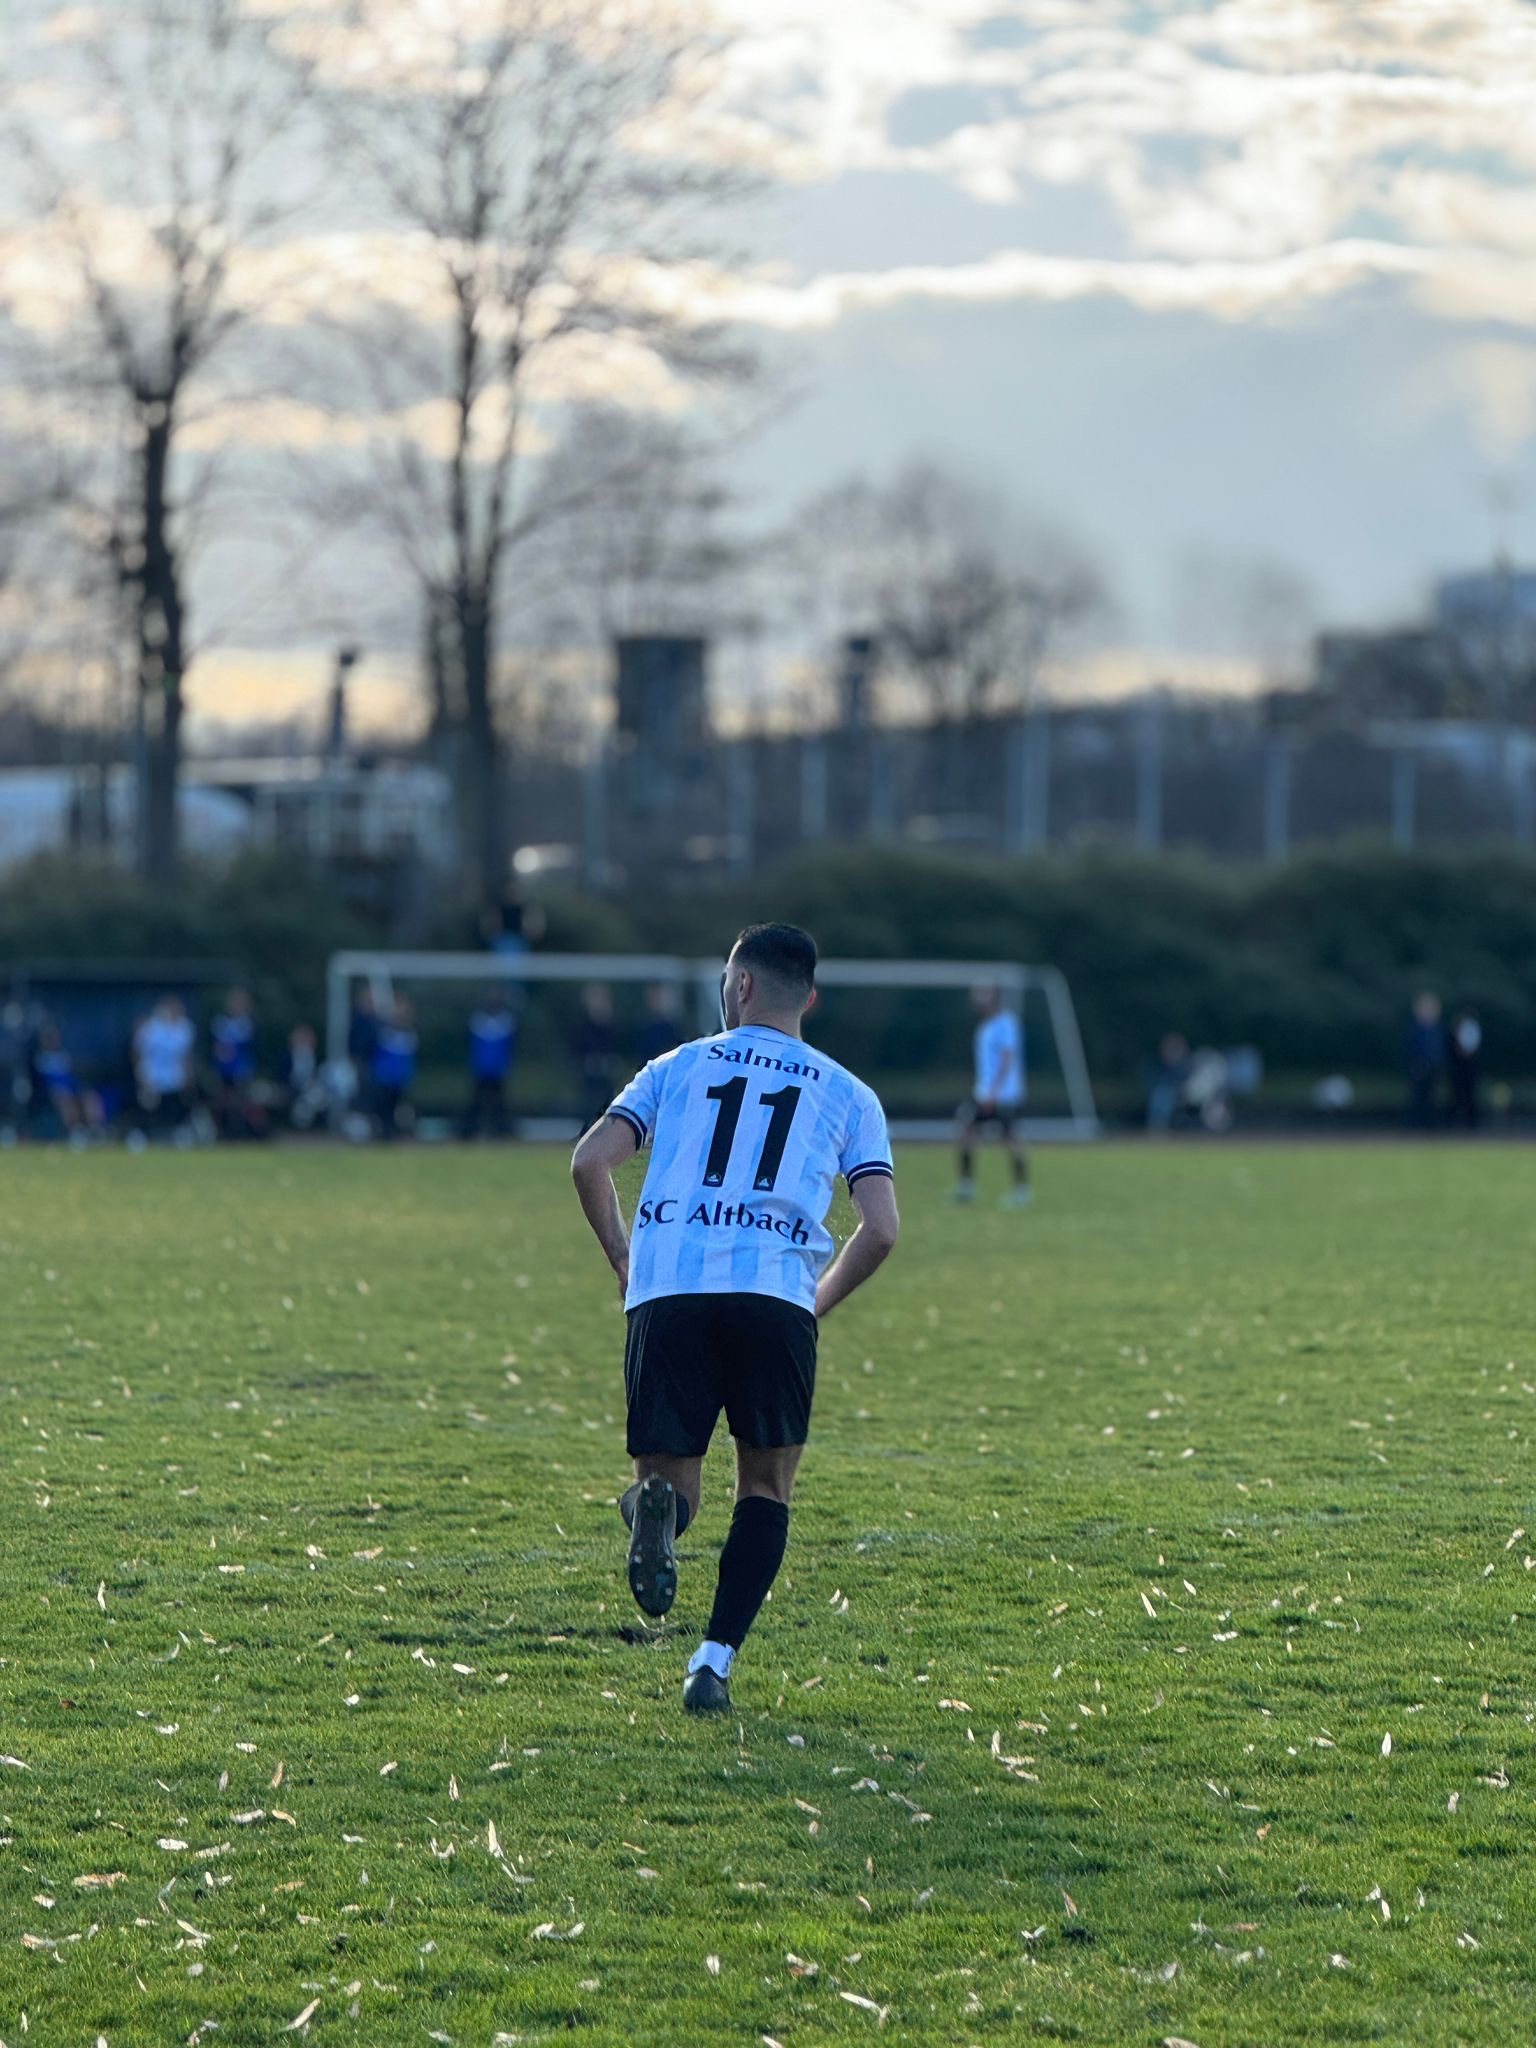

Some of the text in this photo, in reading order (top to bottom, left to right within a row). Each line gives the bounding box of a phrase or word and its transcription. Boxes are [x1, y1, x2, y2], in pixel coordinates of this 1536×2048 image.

[707, 1043, 820, 1081] Salman
[702, 1075, 802, 1192] 11
[638, 1200, 809, 1246] SC Altbach
